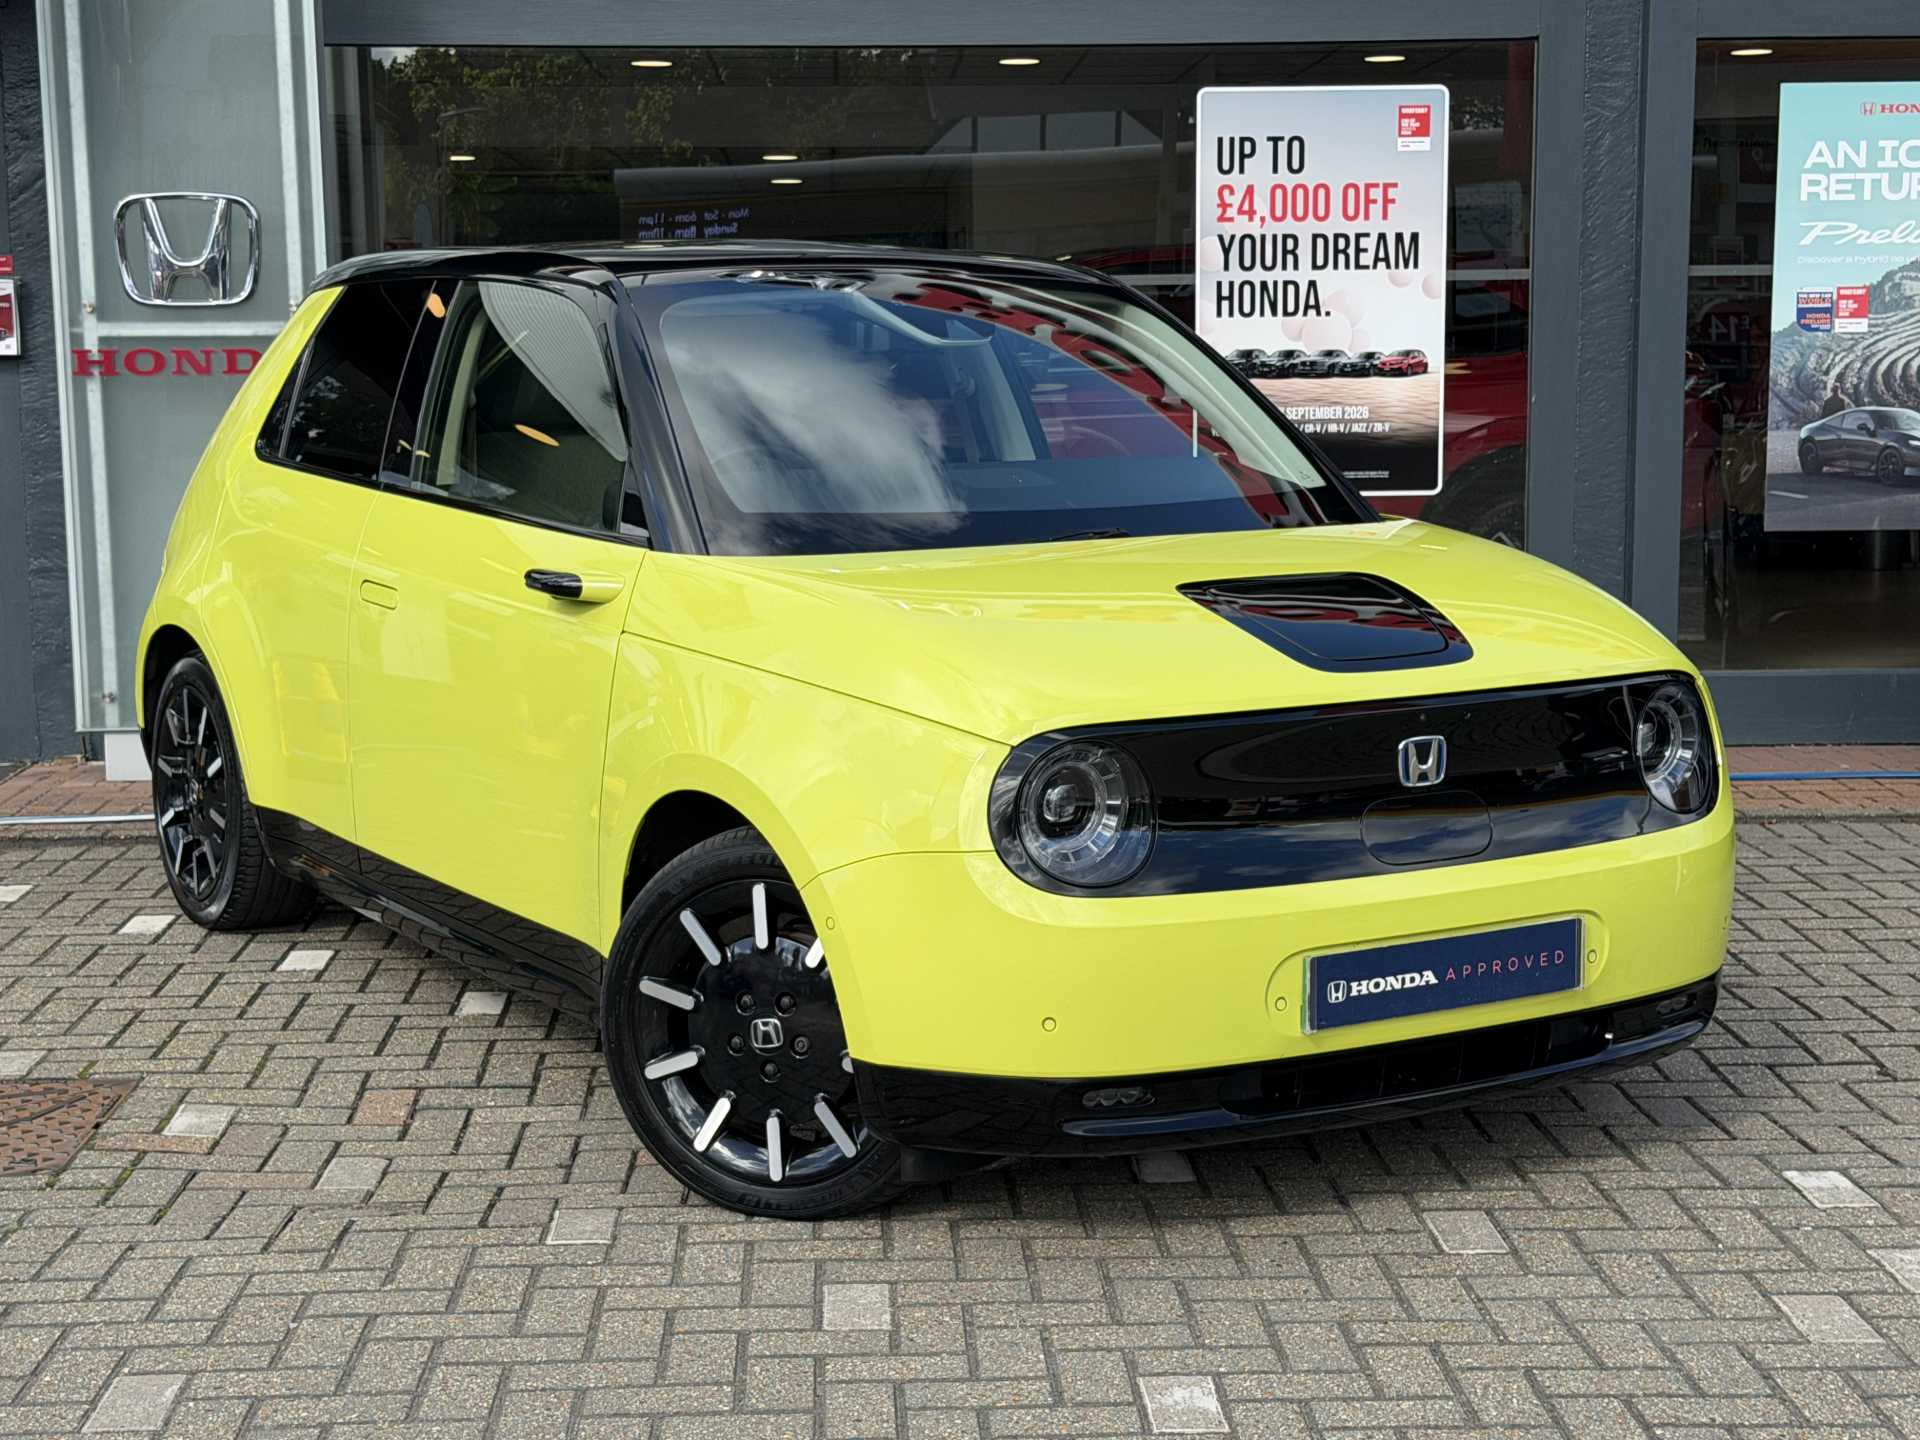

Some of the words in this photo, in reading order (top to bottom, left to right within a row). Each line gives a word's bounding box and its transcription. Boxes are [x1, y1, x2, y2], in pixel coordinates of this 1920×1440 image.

[1216, 137, 1257, 175] UP
[1266, 135, 1306, 174] TO
[1803, 140, 1867, 168] AN
[1216, 183, 1331, 229] £4,000
[1341, 182, 1400, 221] OFF
[1217, 233, 1300, 272] YOUR
[1311, 231, 1420, 271] DREAM
[1216, 280, 1332, 318] HONDA.
[71, 347, 263, 377] HOND
[1286, 406, 1342, 420] SEPTEMBER
[1351, 422, 1367, 433] JAZZ
[1349, 969, 1439, 997] HONDA
[1445, 950, 1565, 982] APPROVED
